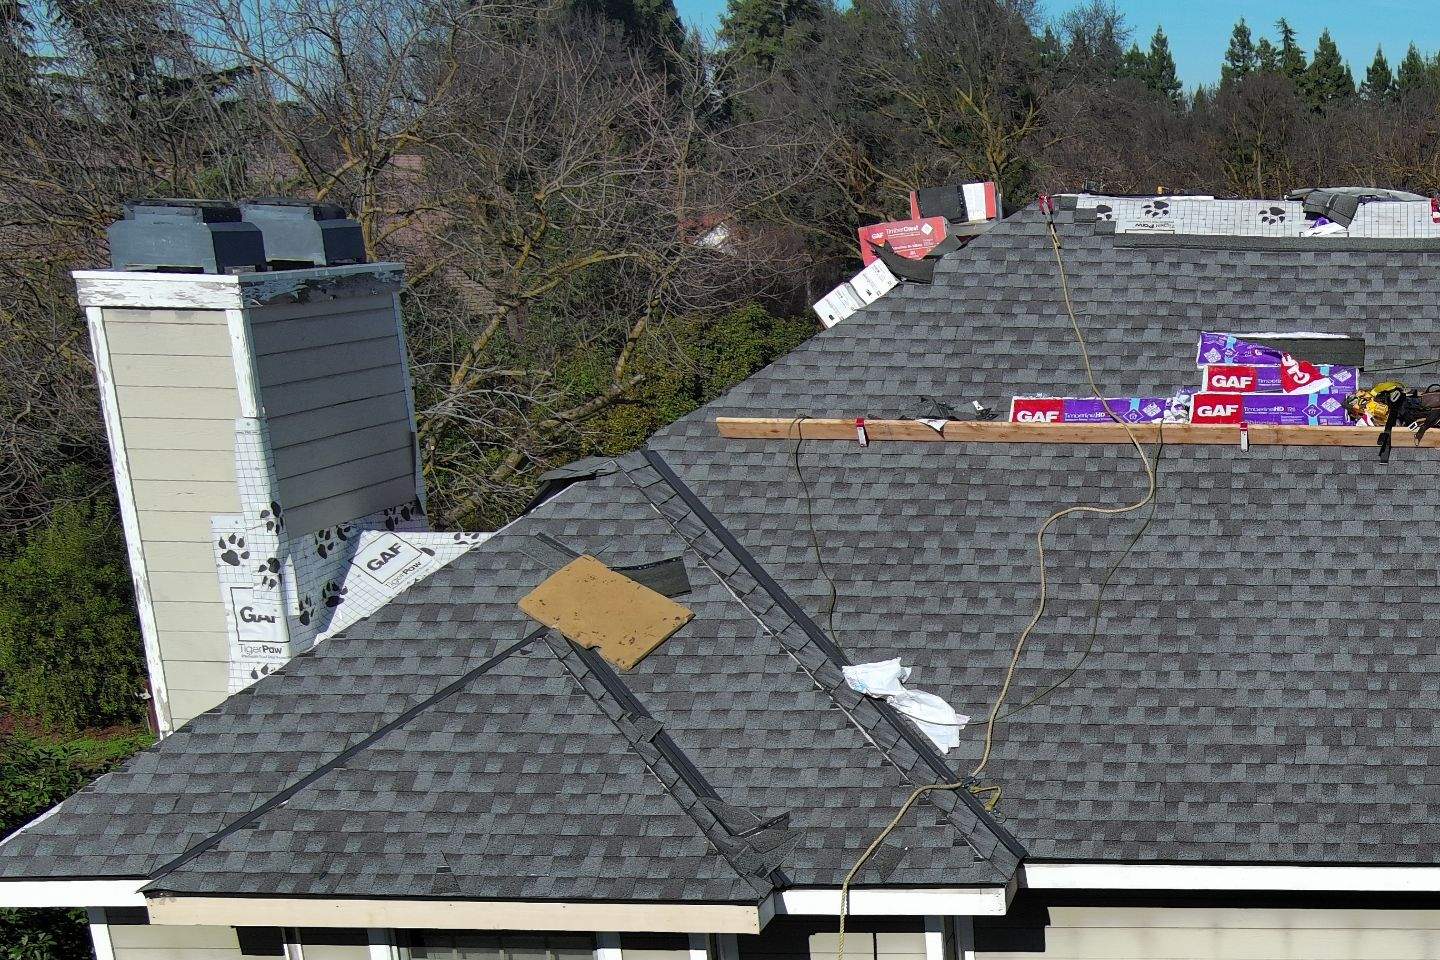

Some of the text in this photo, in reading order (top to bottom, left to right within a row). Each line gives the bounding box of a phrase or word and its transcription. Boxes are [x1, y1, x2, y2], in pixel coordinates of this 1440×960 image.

[1211, 375, 1253, 388] GAF
[1016, 410, 1060, 423] GAF
[1197, 404, 1239, 417] GAF
[366, 542, 402, 571] GAF
[237, 644, 282, 655] TigerPaw
